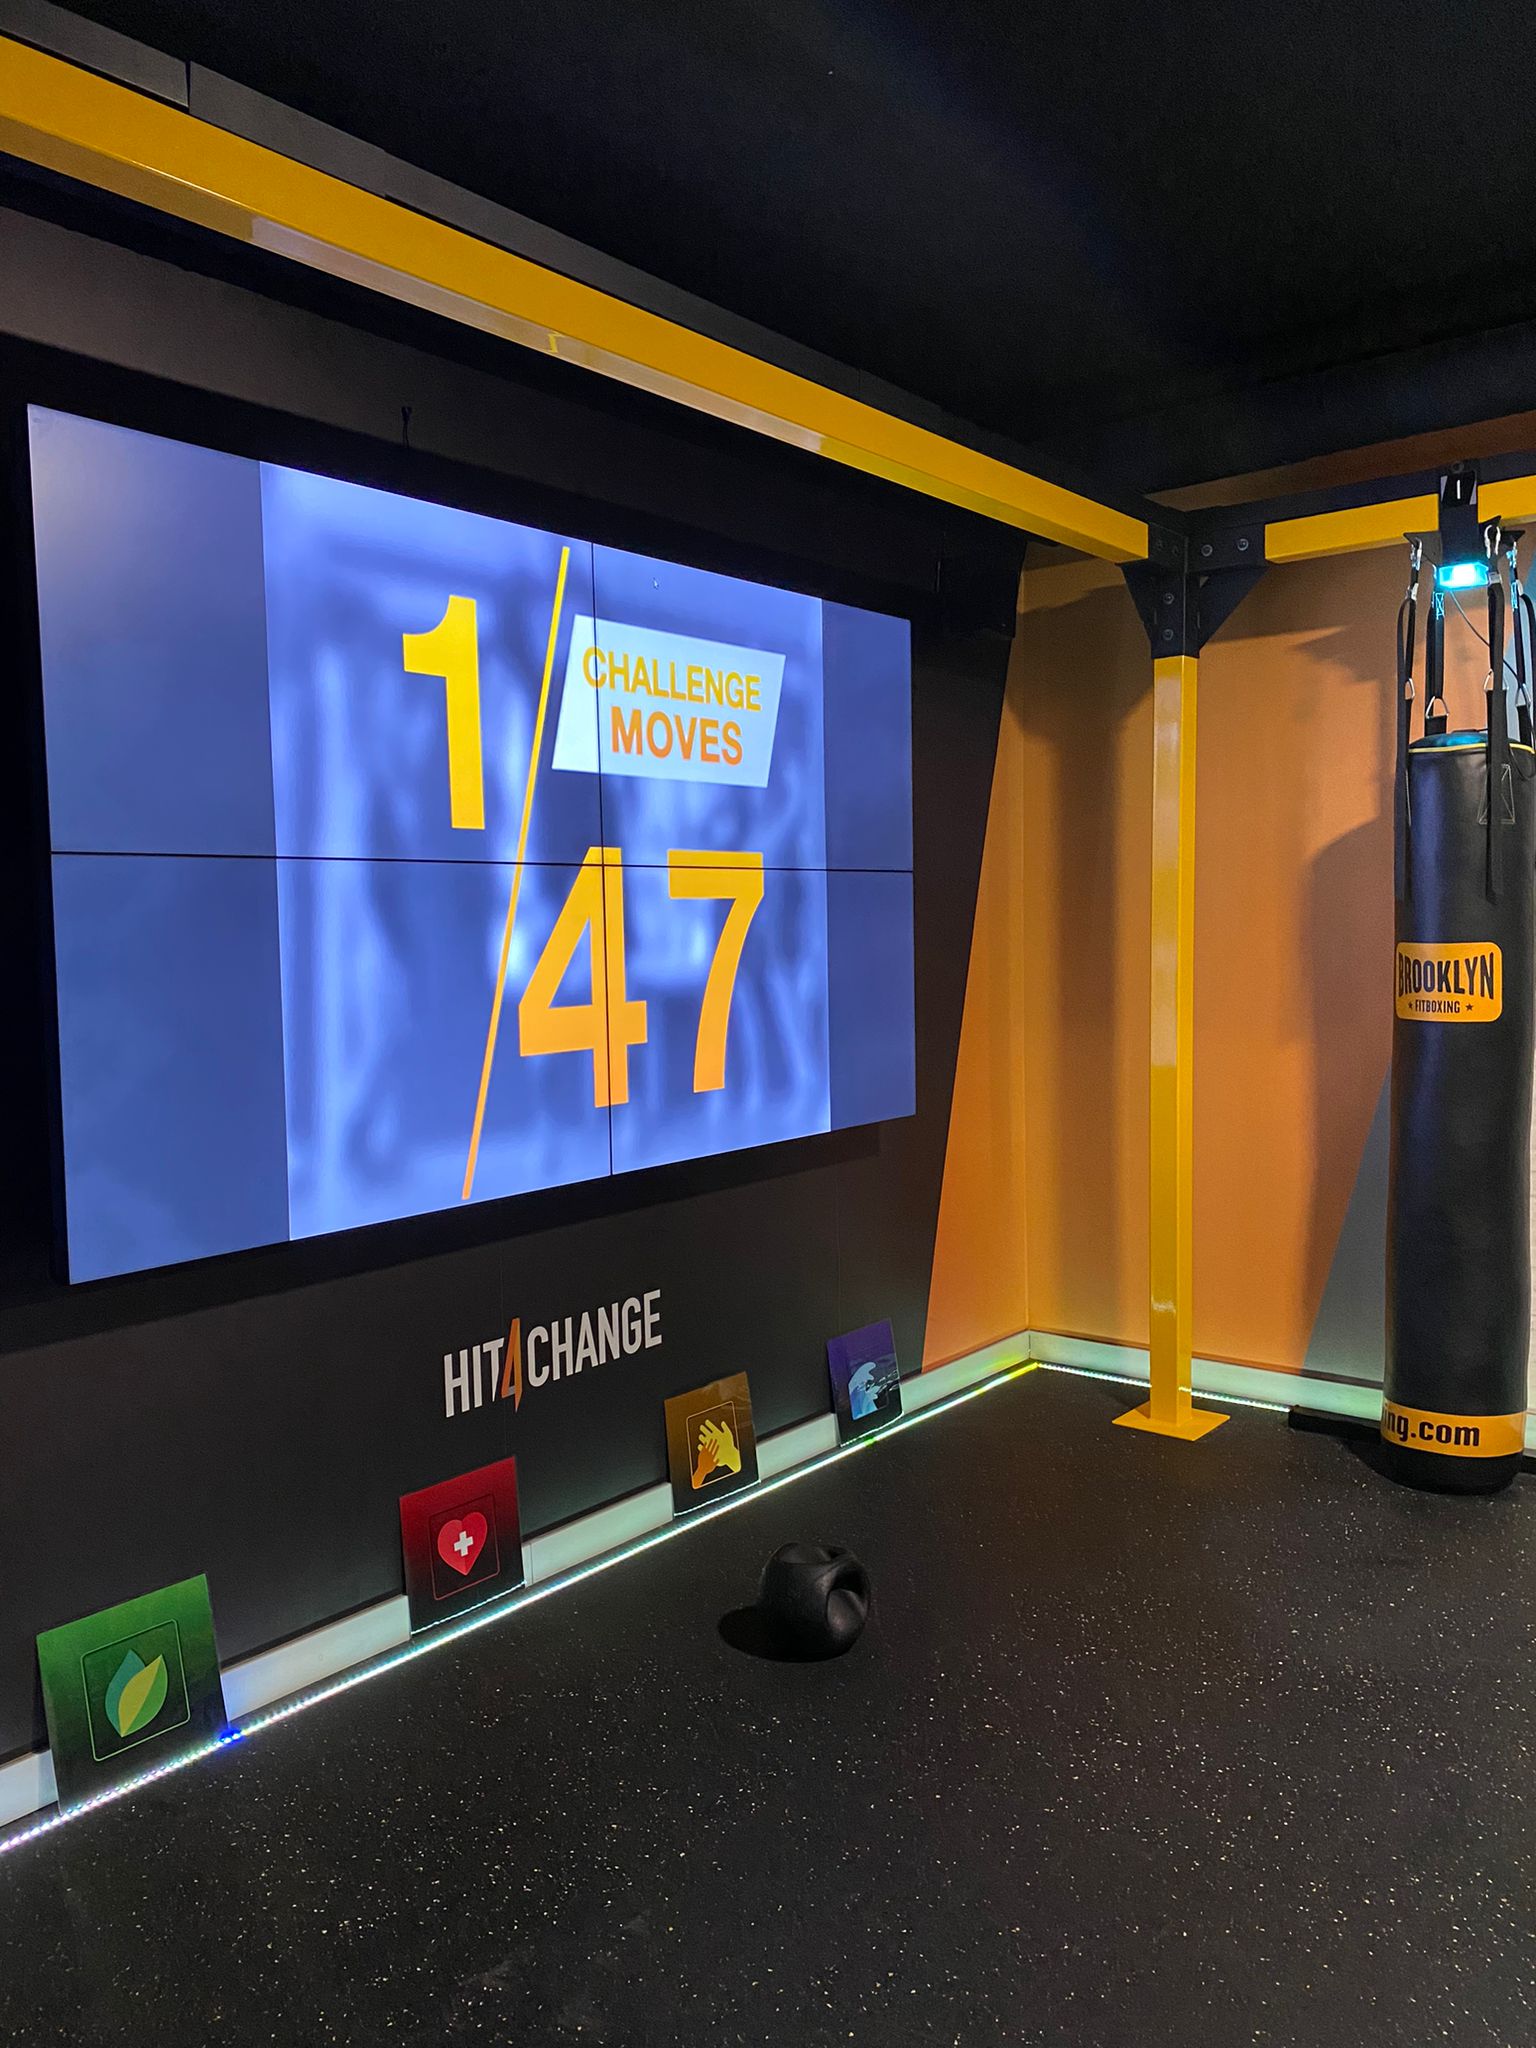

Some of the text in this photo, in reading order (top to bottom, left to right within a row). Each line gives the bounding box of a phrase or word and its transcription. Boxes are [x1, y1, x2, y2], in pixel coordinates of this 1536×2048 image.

[582, 646, 762, 712] CHALLENGE
[403, 594, 485, 830] 1
[610, 706, 744, 766] MOVES
[518, 846, 764, 1108] 47
[1398, 951, 1494, 1000] BROOKLYN
[1415, 1000, 1461, 1014] FITBOXING
